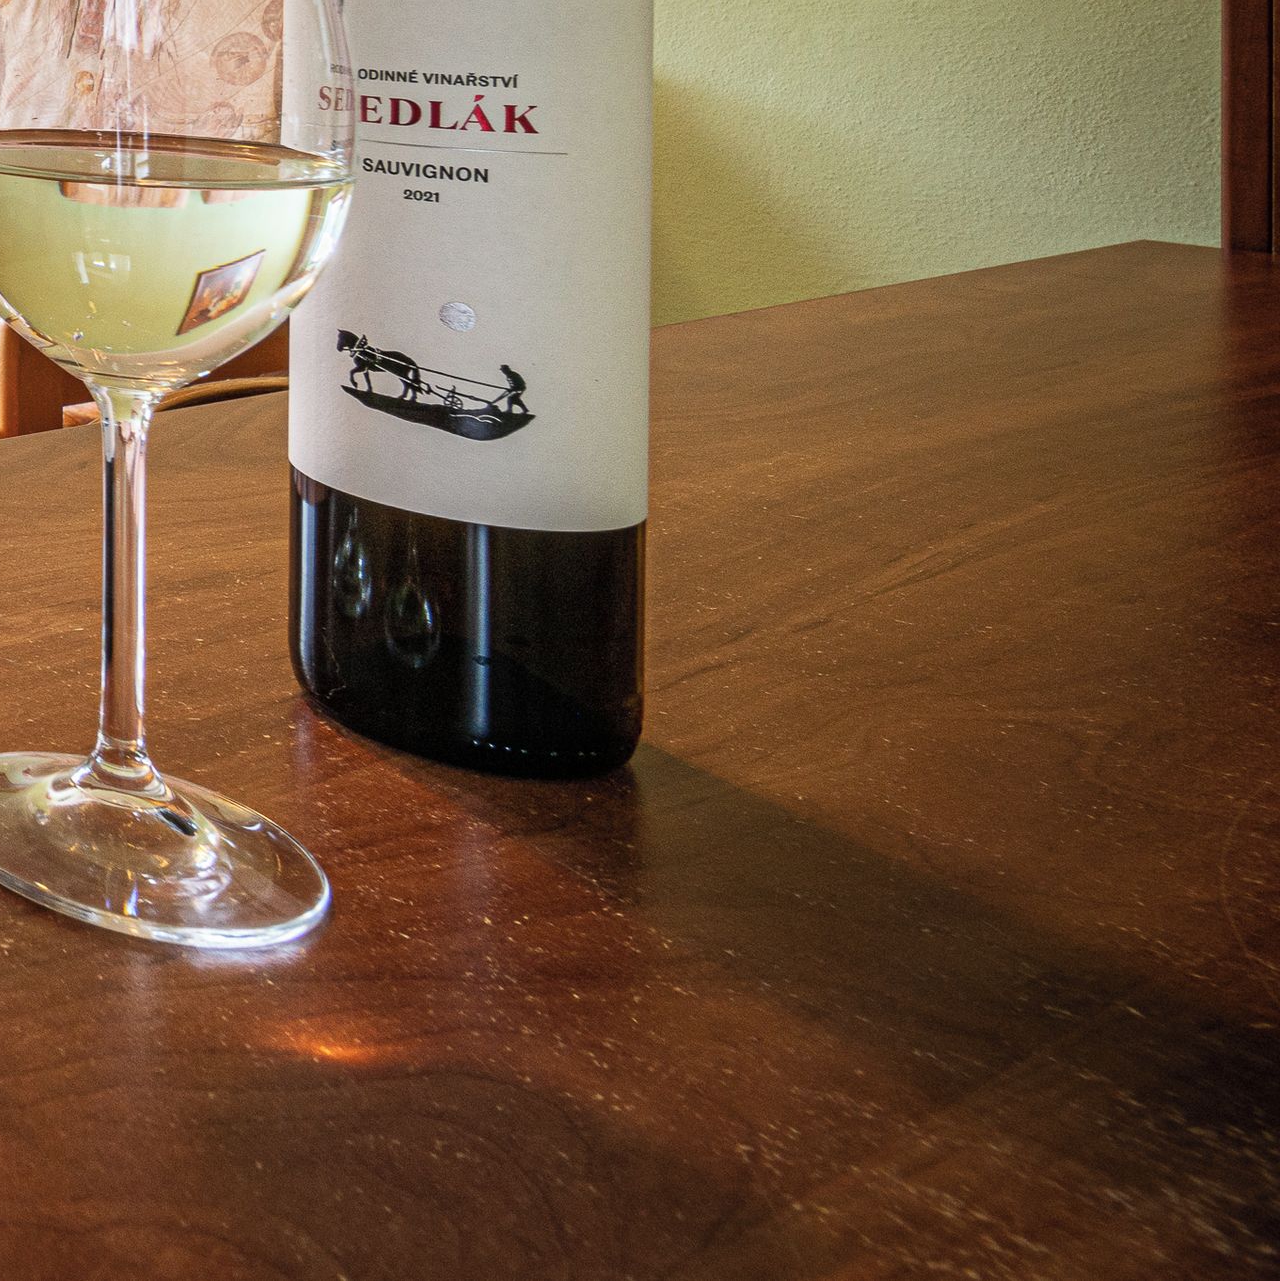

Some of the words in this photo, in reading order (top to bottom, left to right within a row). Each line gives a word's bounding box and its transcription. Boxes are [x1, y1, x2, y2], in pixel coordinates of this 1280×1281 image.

[422, 72, 519, 89] VINAŘSTVÍ
[362, 157, 489, 183] SAUVIGNON
[403, 189, 440, 203] 2021
